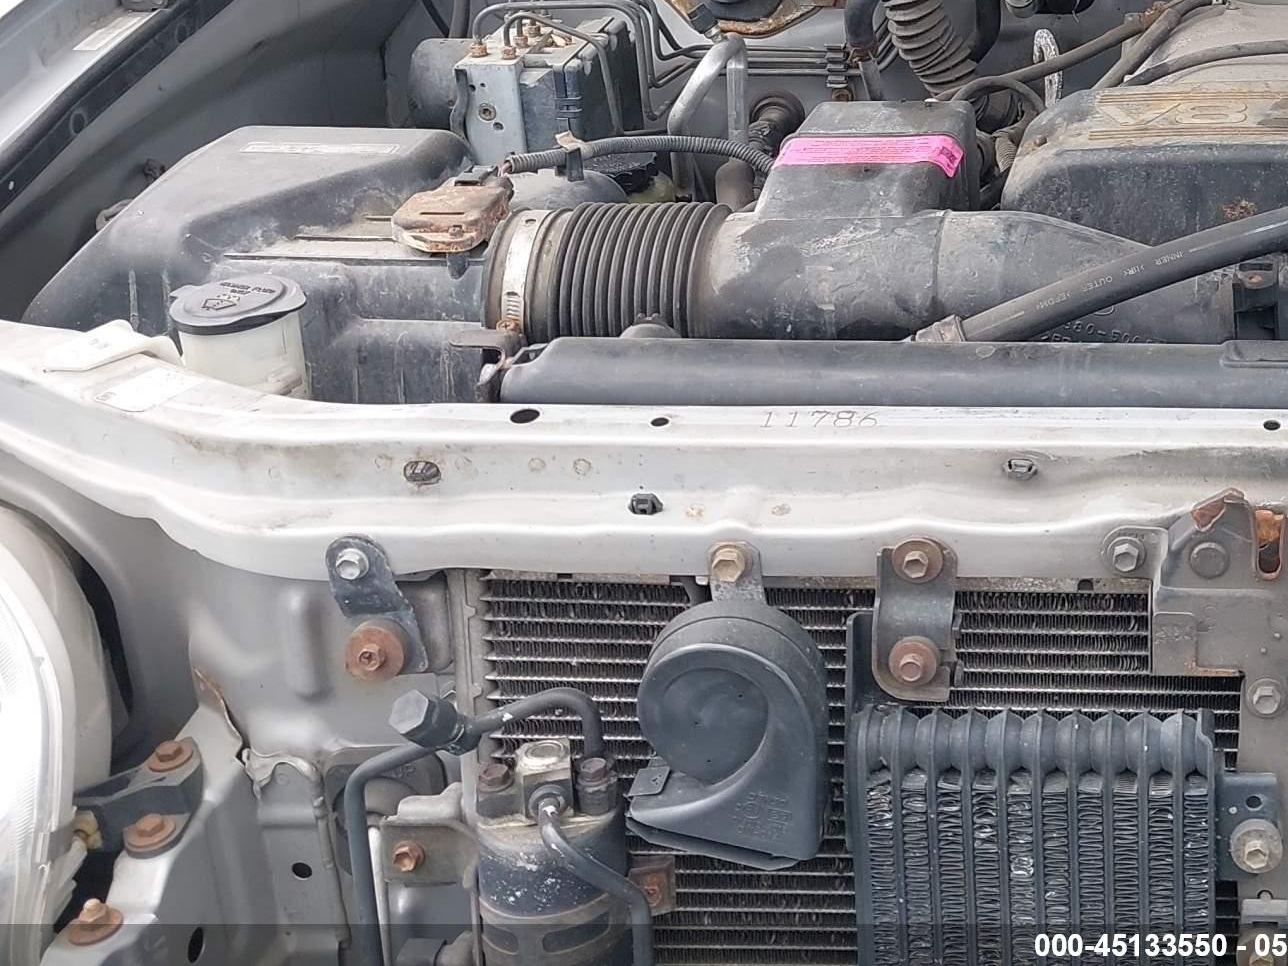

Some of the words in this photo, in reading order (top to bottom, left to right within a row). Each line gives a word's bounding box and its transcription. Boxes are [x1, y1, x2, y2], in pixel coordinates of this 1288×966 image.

[1099, 102, 1249, 127] V8
[1153, 250, 1184, 267] INNER
[759, 410, 879, 428] 11786
